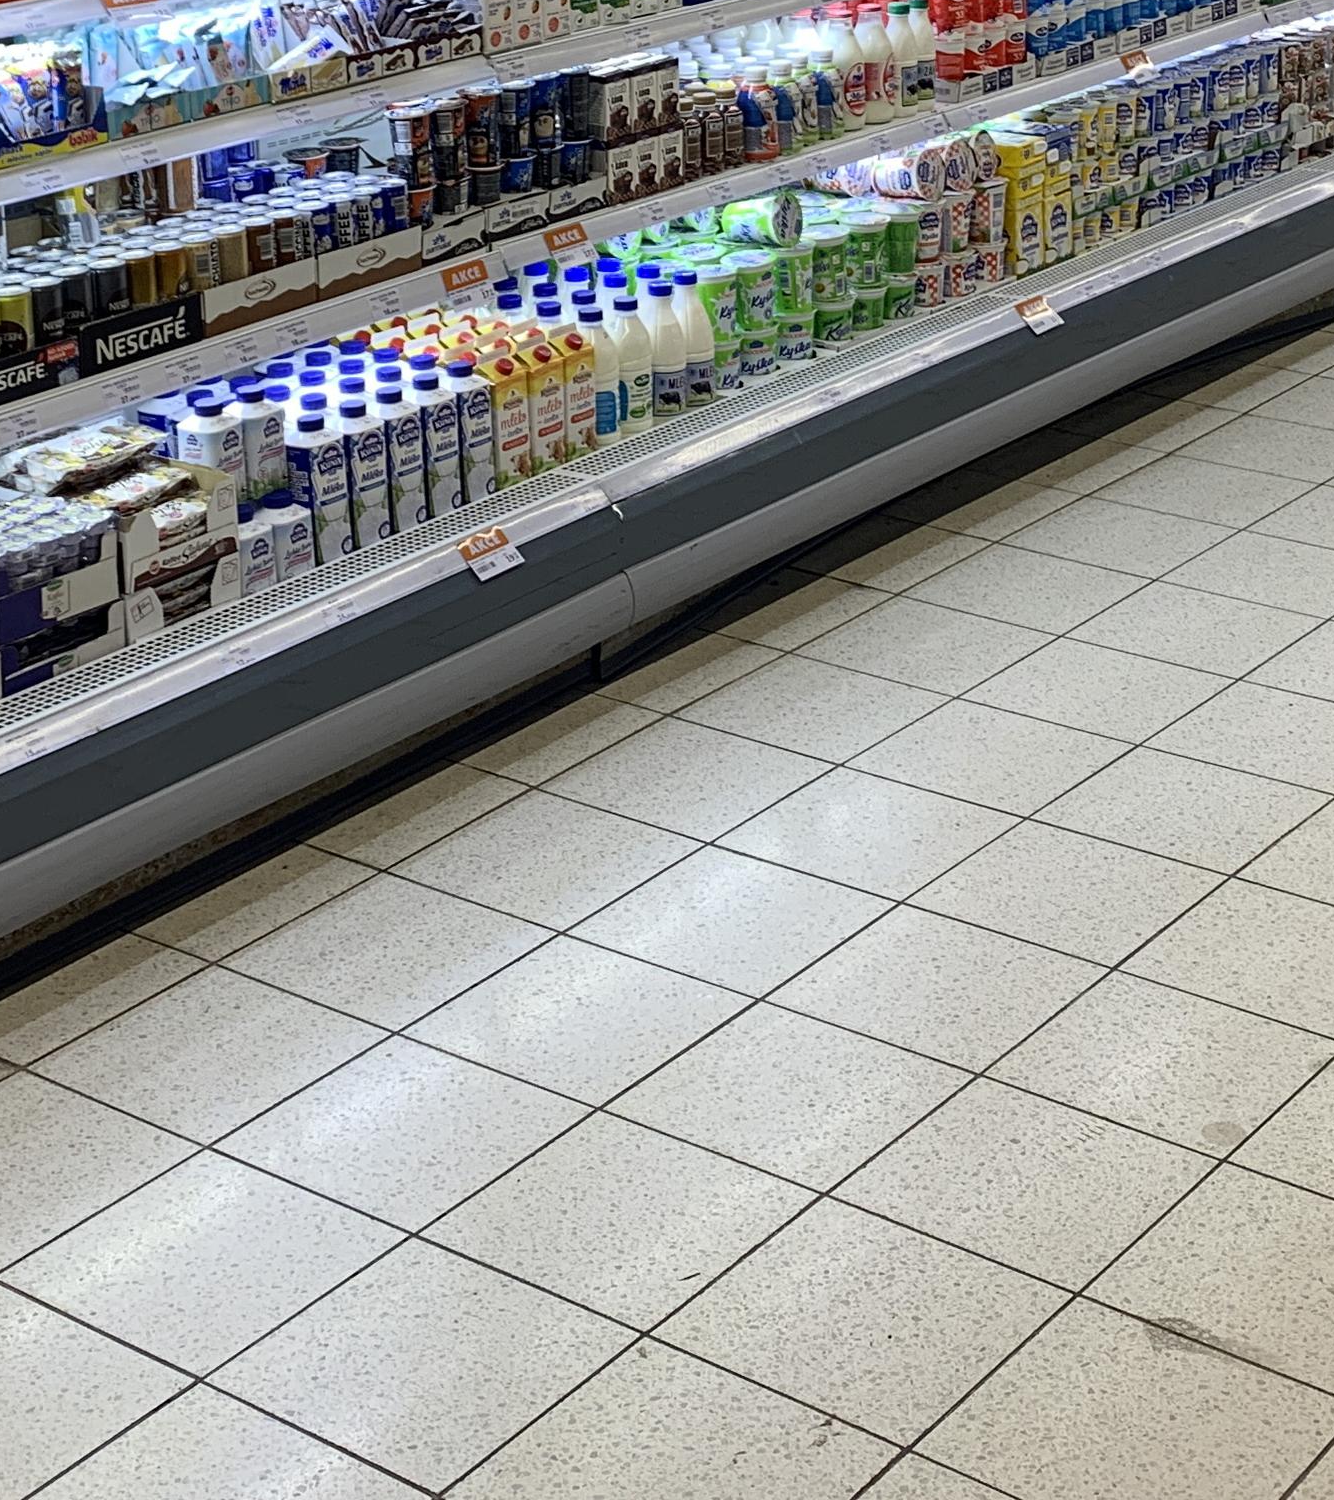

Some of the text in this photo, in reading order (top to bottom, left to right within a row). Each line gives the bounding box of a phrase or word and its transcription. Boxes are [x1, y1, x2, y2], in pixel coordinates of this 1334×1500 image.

[68, 127, 99, 147] bobik
[552, 228, 583, 247] AKCE
[451, 266, 482, 286] AKCE
[96, 305, 186, 365] NESCAFÉ
[778, 341, 813, 360] Kyška
[740, 357, 775, 376] Kyška
[468, 533, 502, 556] AKCE
